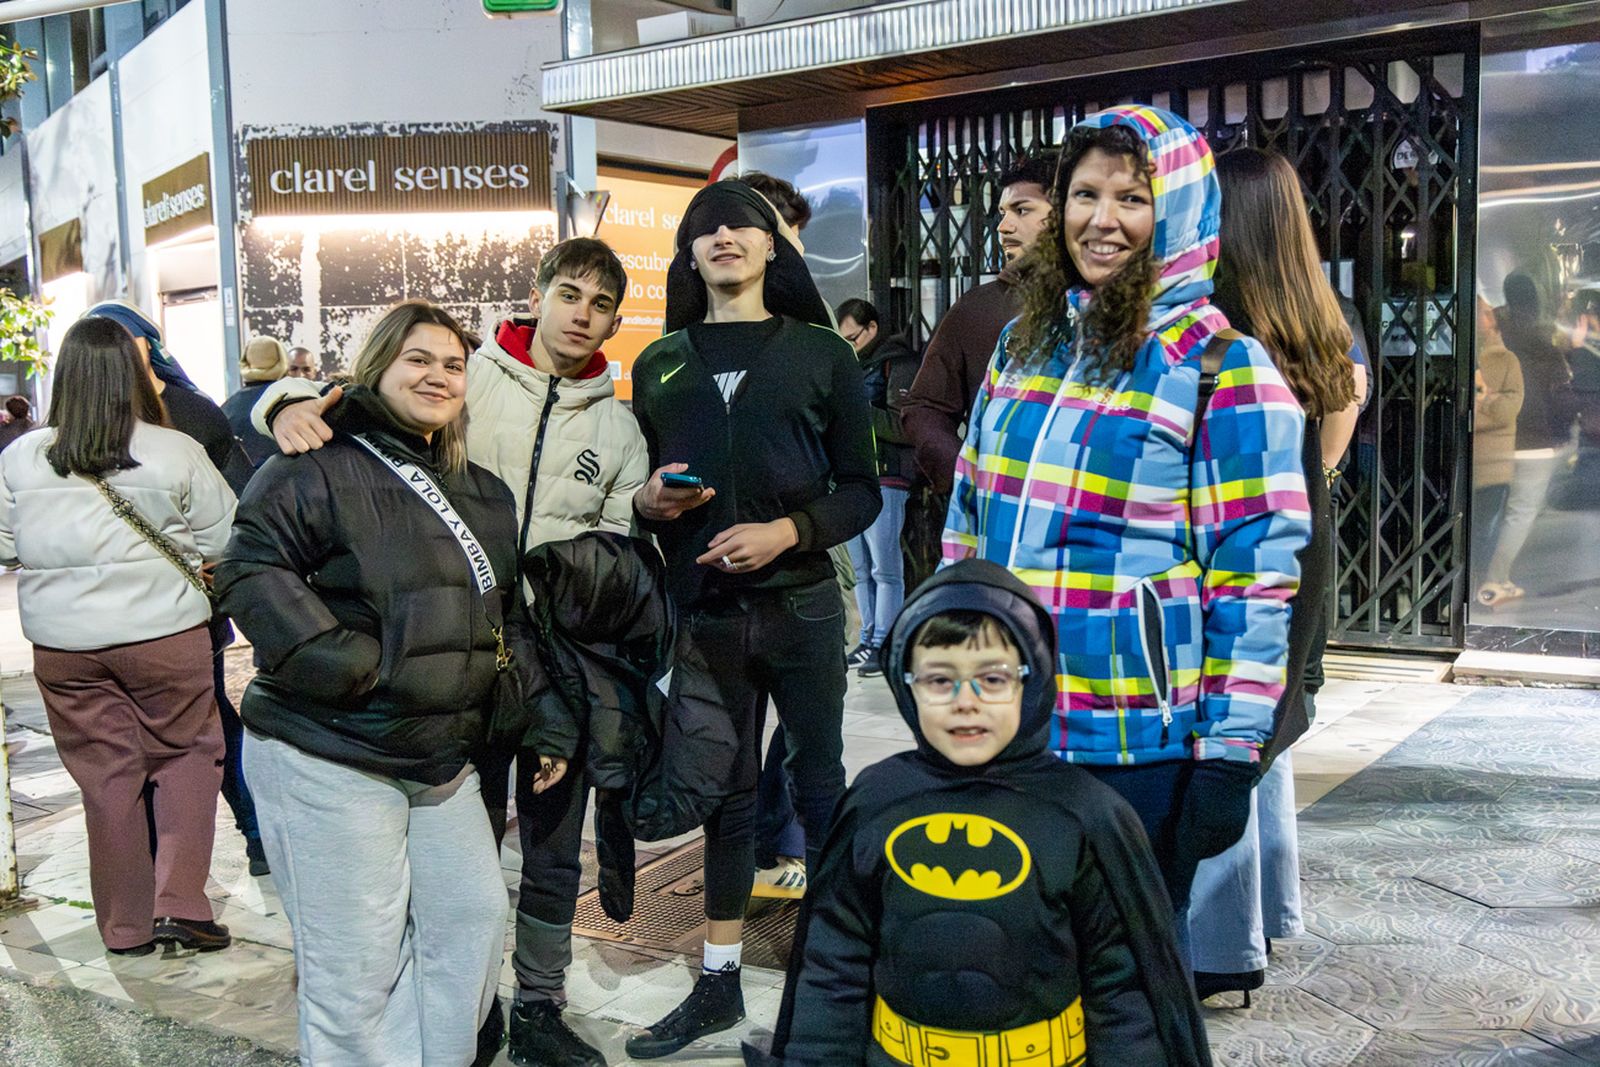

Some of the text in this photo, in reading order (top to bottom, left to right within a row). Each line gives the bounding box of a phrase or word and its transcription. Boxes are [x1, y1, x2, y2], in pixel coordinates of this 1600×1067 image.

[270, 160, 530, 194] clarel senses
[602, 202, 655, 228] clarel
[612, 251, 674, 272] escubr
[629, 279, 665, 300] lo co
[410, 470, 493, 590] BIMBA Y LOLA
